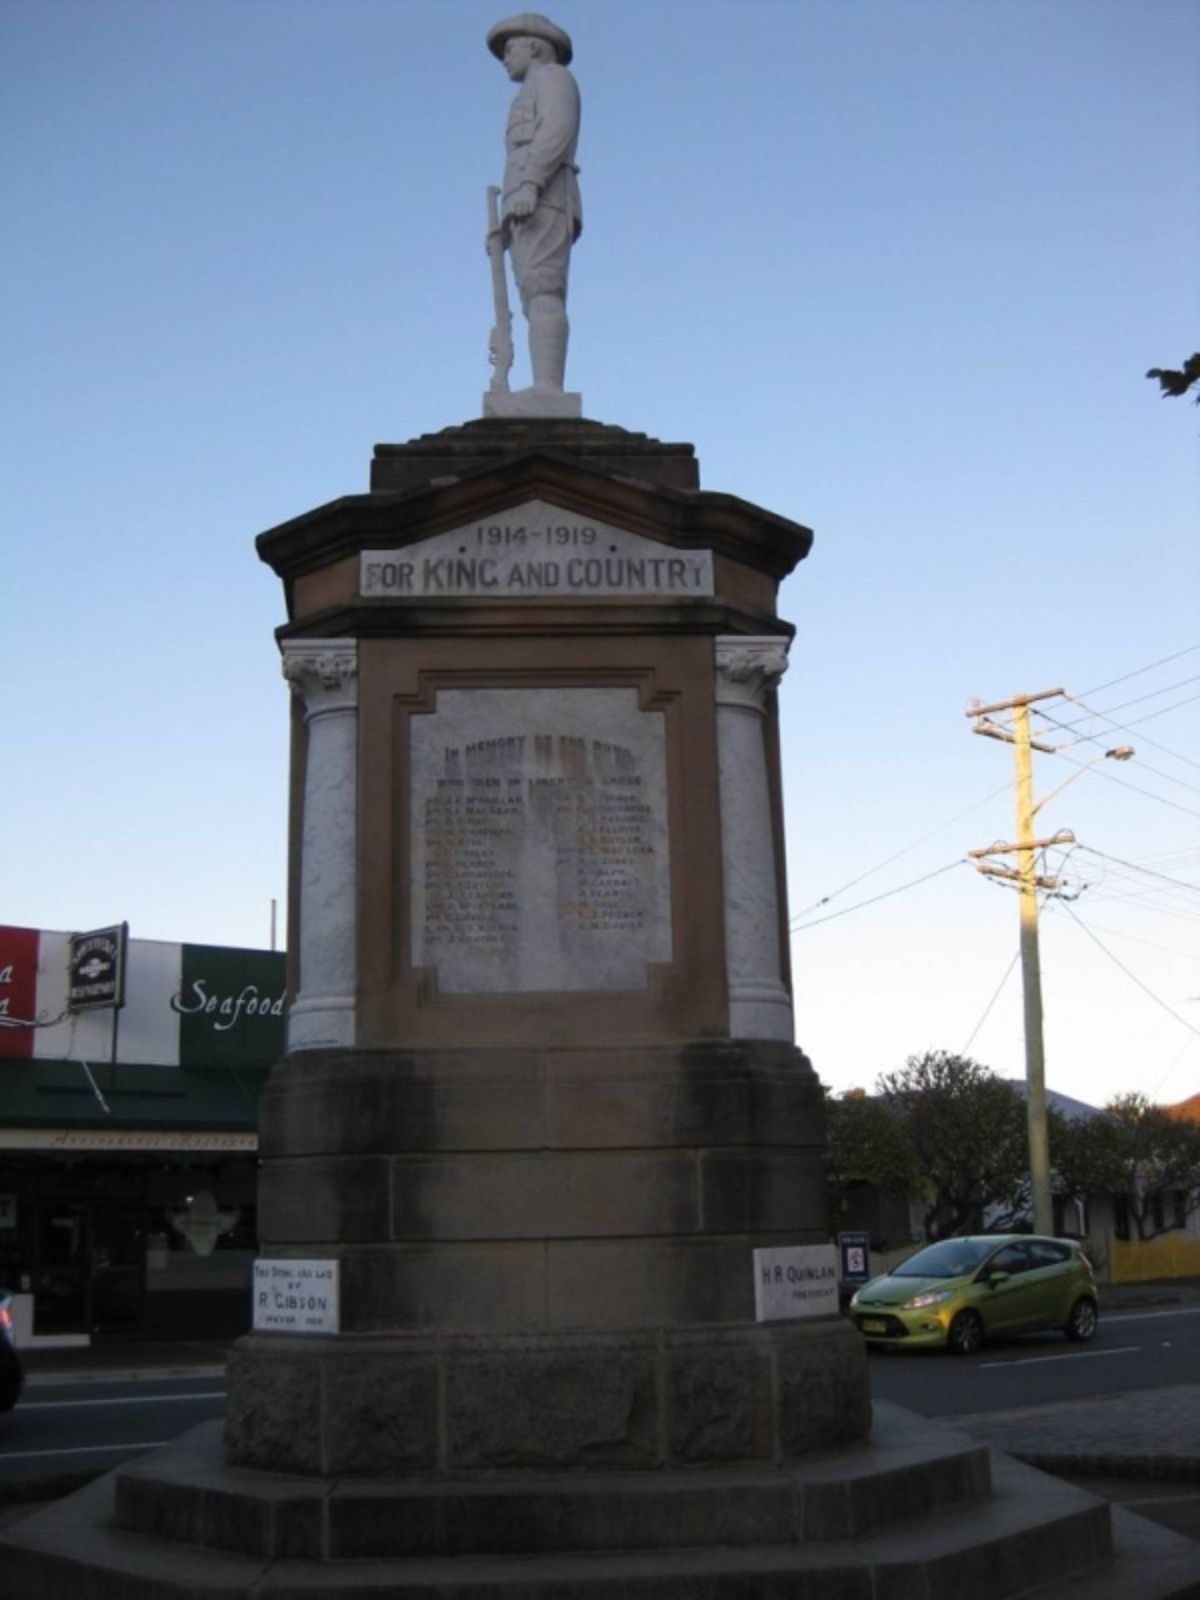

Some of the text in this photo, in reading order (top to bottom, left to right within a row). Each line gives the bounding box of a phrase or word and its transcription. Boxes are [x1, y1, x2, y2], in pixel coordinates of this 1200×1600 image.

[476, 526, 597, 546] 1914-1919
[365, 558, 702, 590] FOR KING AND COUNTRY
[170, 979, 287, 1031] Seafood
